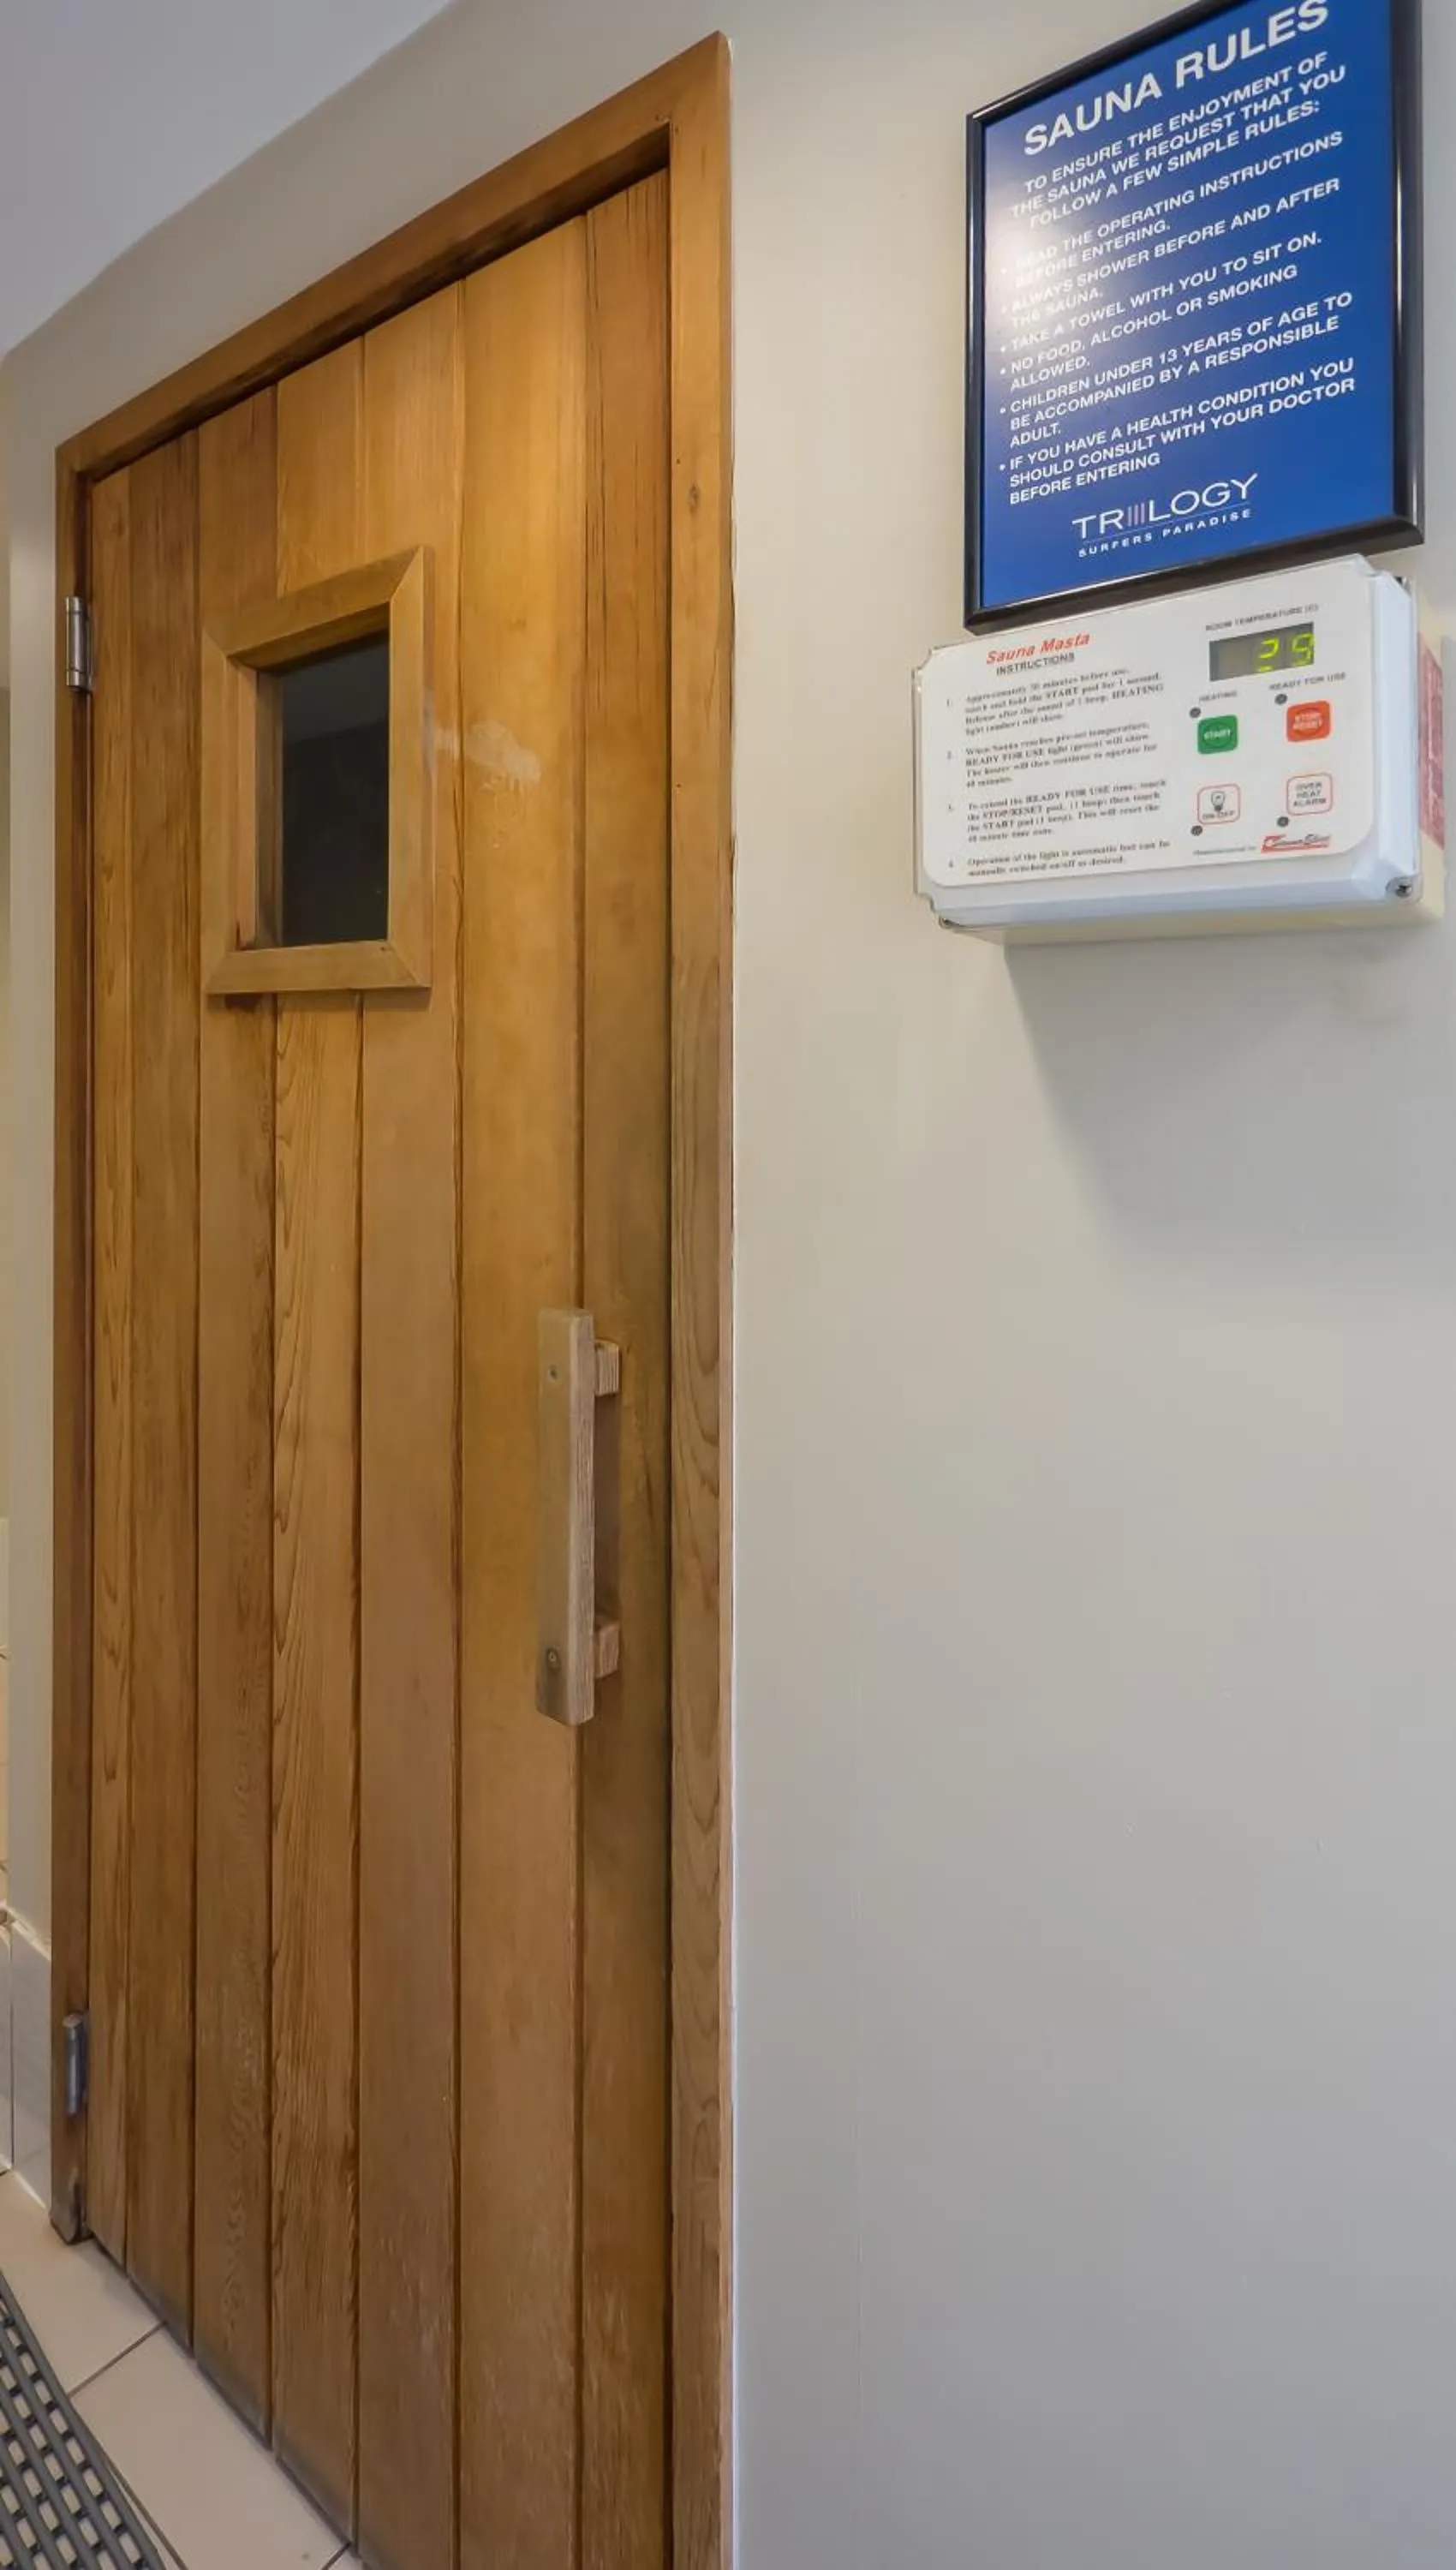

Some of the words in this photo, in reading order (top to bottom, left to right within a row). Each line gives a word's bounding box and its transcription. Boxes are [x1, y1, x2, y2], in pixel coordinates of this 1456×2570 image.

[1024, 73, 1161, 155] SAUNA
[1176, 0, 1328, 88] RULES
[1009, 194, 1042, 218] THE
[1047, 169, 1107, 202] SAUNA
[1112, 152, 1139, 175] WE
[1145, 111, 1235, 161] REQUEST
[1240, 87, 1292, 120] THAT
[1299, 65, 1346, 94] YOU
[1024, 175, 1047, 193] TO
[1053, 140, 1122, 182] ENSURE
[1127, 123, 1163, 147] THE
[1169, 66, 1292, 131] ENJOYMENT
[1298, 51, 1328, 75] OF
[1030, 188, 1101, 228] FOLLOW
[1106, 183, 1118, 198] A
[1124, 163, 1161, 190] FEW
[1167, 130, 1238, 171] SIMPLE
[1245, 101, 1319, 140] RULES:
[1063, 230, 1092, 251] THE
[1098, 190, 1194, 236] OPERATING
[1200, 131, 1342, 197] INSTRUCTIONS
[1011, 279, 1072, 312] ALWAYS
[1077, 250, 1149, 286] SHOWER
[1155, 220, 1225, 257] BEFORE
[1231, 204, 1270, 230] AND
[1276, 178, 1339, 212] AFTER
[1083, 219, 1170, 261] ENTERING.
[1011, 329, 1049, 350] TAKE
[1053, 324, 1064, 336] A
[1070, 302, 1125, 329] TOWEL
[1131, 283, 1173, 308] WITH
[1179, 267, 1216, 290] YOU
[1222, 257, 1247, 274] TO
[1253, 243, 1281, 264] SIT
[1287, 231, 1321, 252] ON.
[1011, 356, 1033, 374] NO
[1038, 339, 1085, 363] FOOD,
[1091, 309, 1172, 345] ALCOHOL
[1176, 297, 1202, 315] OR
[1208, 265, 1297, 305] SMOKING
[1046, 288, 1102, 315] SAUNA.
[1010, 377, 1089, 413] CHILDREN
[1095, 356, 1153, 385] UNDER
[1160, 349, 1177, 363] 13
[1182, 327, 1242, 356] YEARS
[1247, 316, 1273, 336] OF
[1278, 302, 1318, 326] AGE
[1323, 292, 1352, 310] TO
[1011, 414, 1029, 430] BE
[1035, 375, 1155, 422] ACCOMPANIED
[1160, 365, 1182, 383] BY
[1188, 361, 1200, 375] A
[1205, 315, 1339, 368] RESPONSIBLE
[1011, 356, 1089, 391] ALLOWED.
[1010, 456, 1023, 469] IF
[1028, 445, 1059, 464] YOU
[1065, 431, 1107, 453] HAVE
[1111, 427, 1122, 440] A
[1127, 404, 1192, 435] HEALTH
[1198, 372, 1304, 413] CONDITION
[1310, 357, 1353, 380] YOU
[1010, 459, 1074, 487] SHOULD
[1078, 434, 1155, 467] CONSULT
[1161, 420, 1205, 444] WITH
[1210, 404, 1263, 428] YOUR
[1269, 378, 1354, 413] DOCTOR
[1010, 421, 1060, 448] ADULT.
[1010, 477, 1071, 505] BEFORE
[1076, 452, 1160, 486] ENTERING
[1078, 533, 1152, 557] SURFERS
[1162, 509, 1250, 536] PARADISE
[987, 645, 1035, 665] Sauna
[1041, 634, 1089, 653] Masta
[996, 653, 1074, 675] INSTRUCTIONS
[1259, 632, 1314, 672] 29
[1047, 686, 1077, 698] START
[1112, 684, 1163, 699] HEATING
[1203, 729, 1231, 739] START
